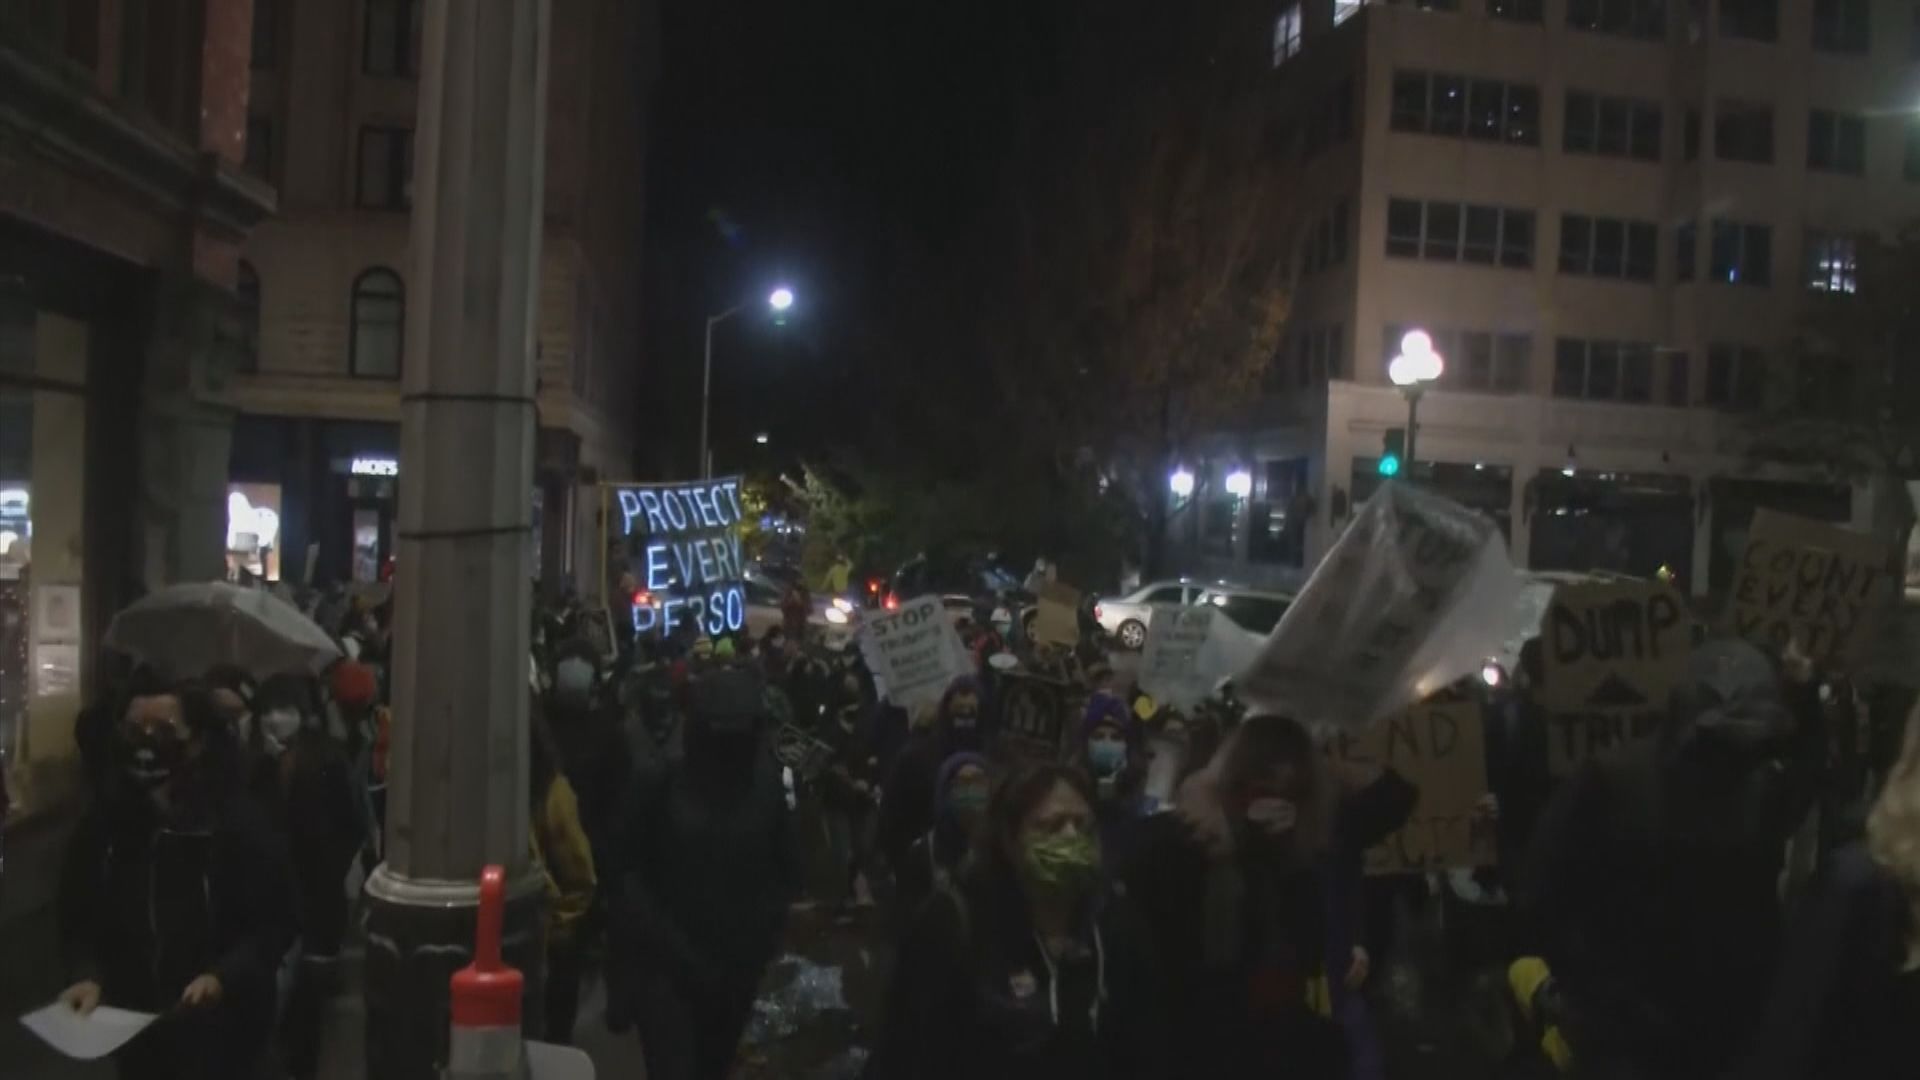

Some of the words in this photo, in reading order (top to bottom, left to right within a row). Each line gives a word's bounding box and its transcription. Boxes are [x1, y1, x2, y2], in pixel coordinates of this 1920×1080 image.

[617, 483, 741, 535] PROTECT
[647, 535, 741, 589] EVERY
[1744, 540, 1888, 597] COUNT
[871, 603, 934, 637] STOP
[1553, 593, 1679, 663] DUMP
[1736, 574, 1860, 634] EVERY
